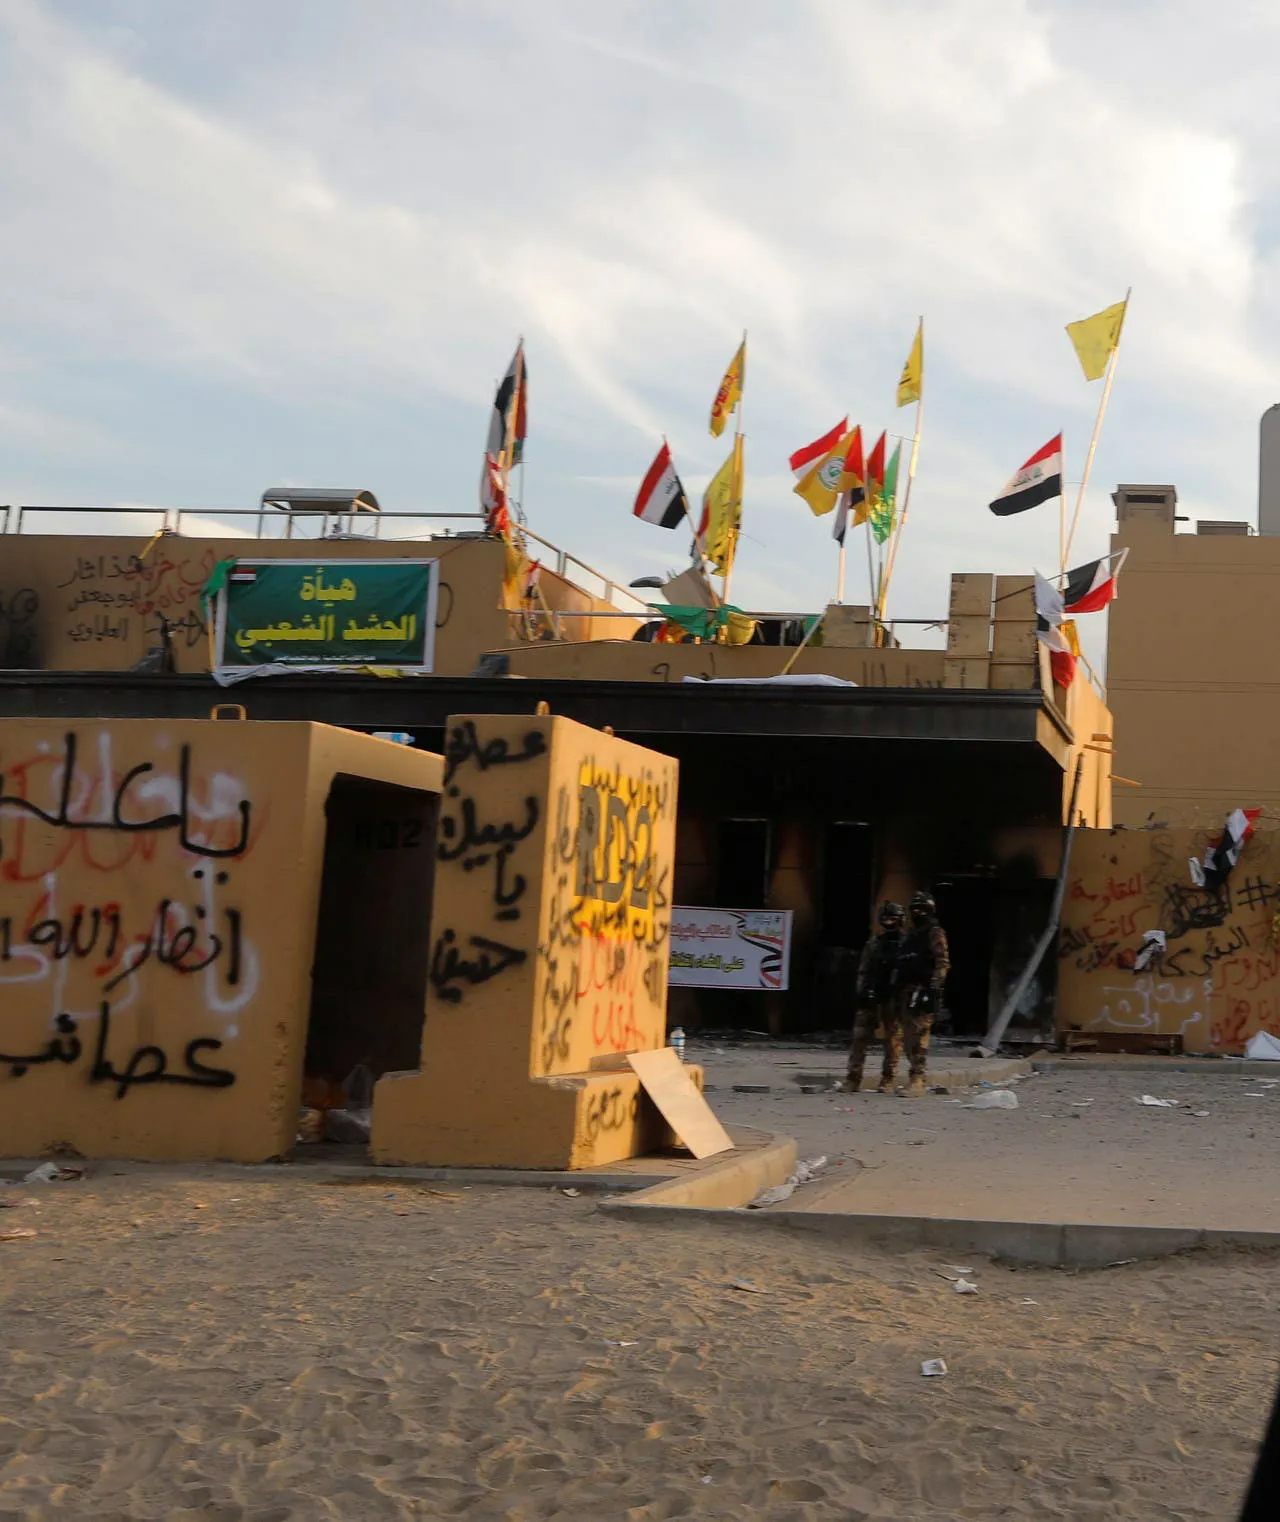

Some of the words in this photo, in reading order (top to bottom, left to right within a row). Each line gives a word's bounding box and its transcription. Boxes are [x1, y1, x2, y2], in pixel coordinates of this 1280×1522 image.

[300, 566, 357, 607] هيأة
[235, 613, 335, 653] الشعبي
[342, 613, 416, 641] الحشد
[355, 818, 422, 850] RD2
[574, 784, 654, 911] RD2
